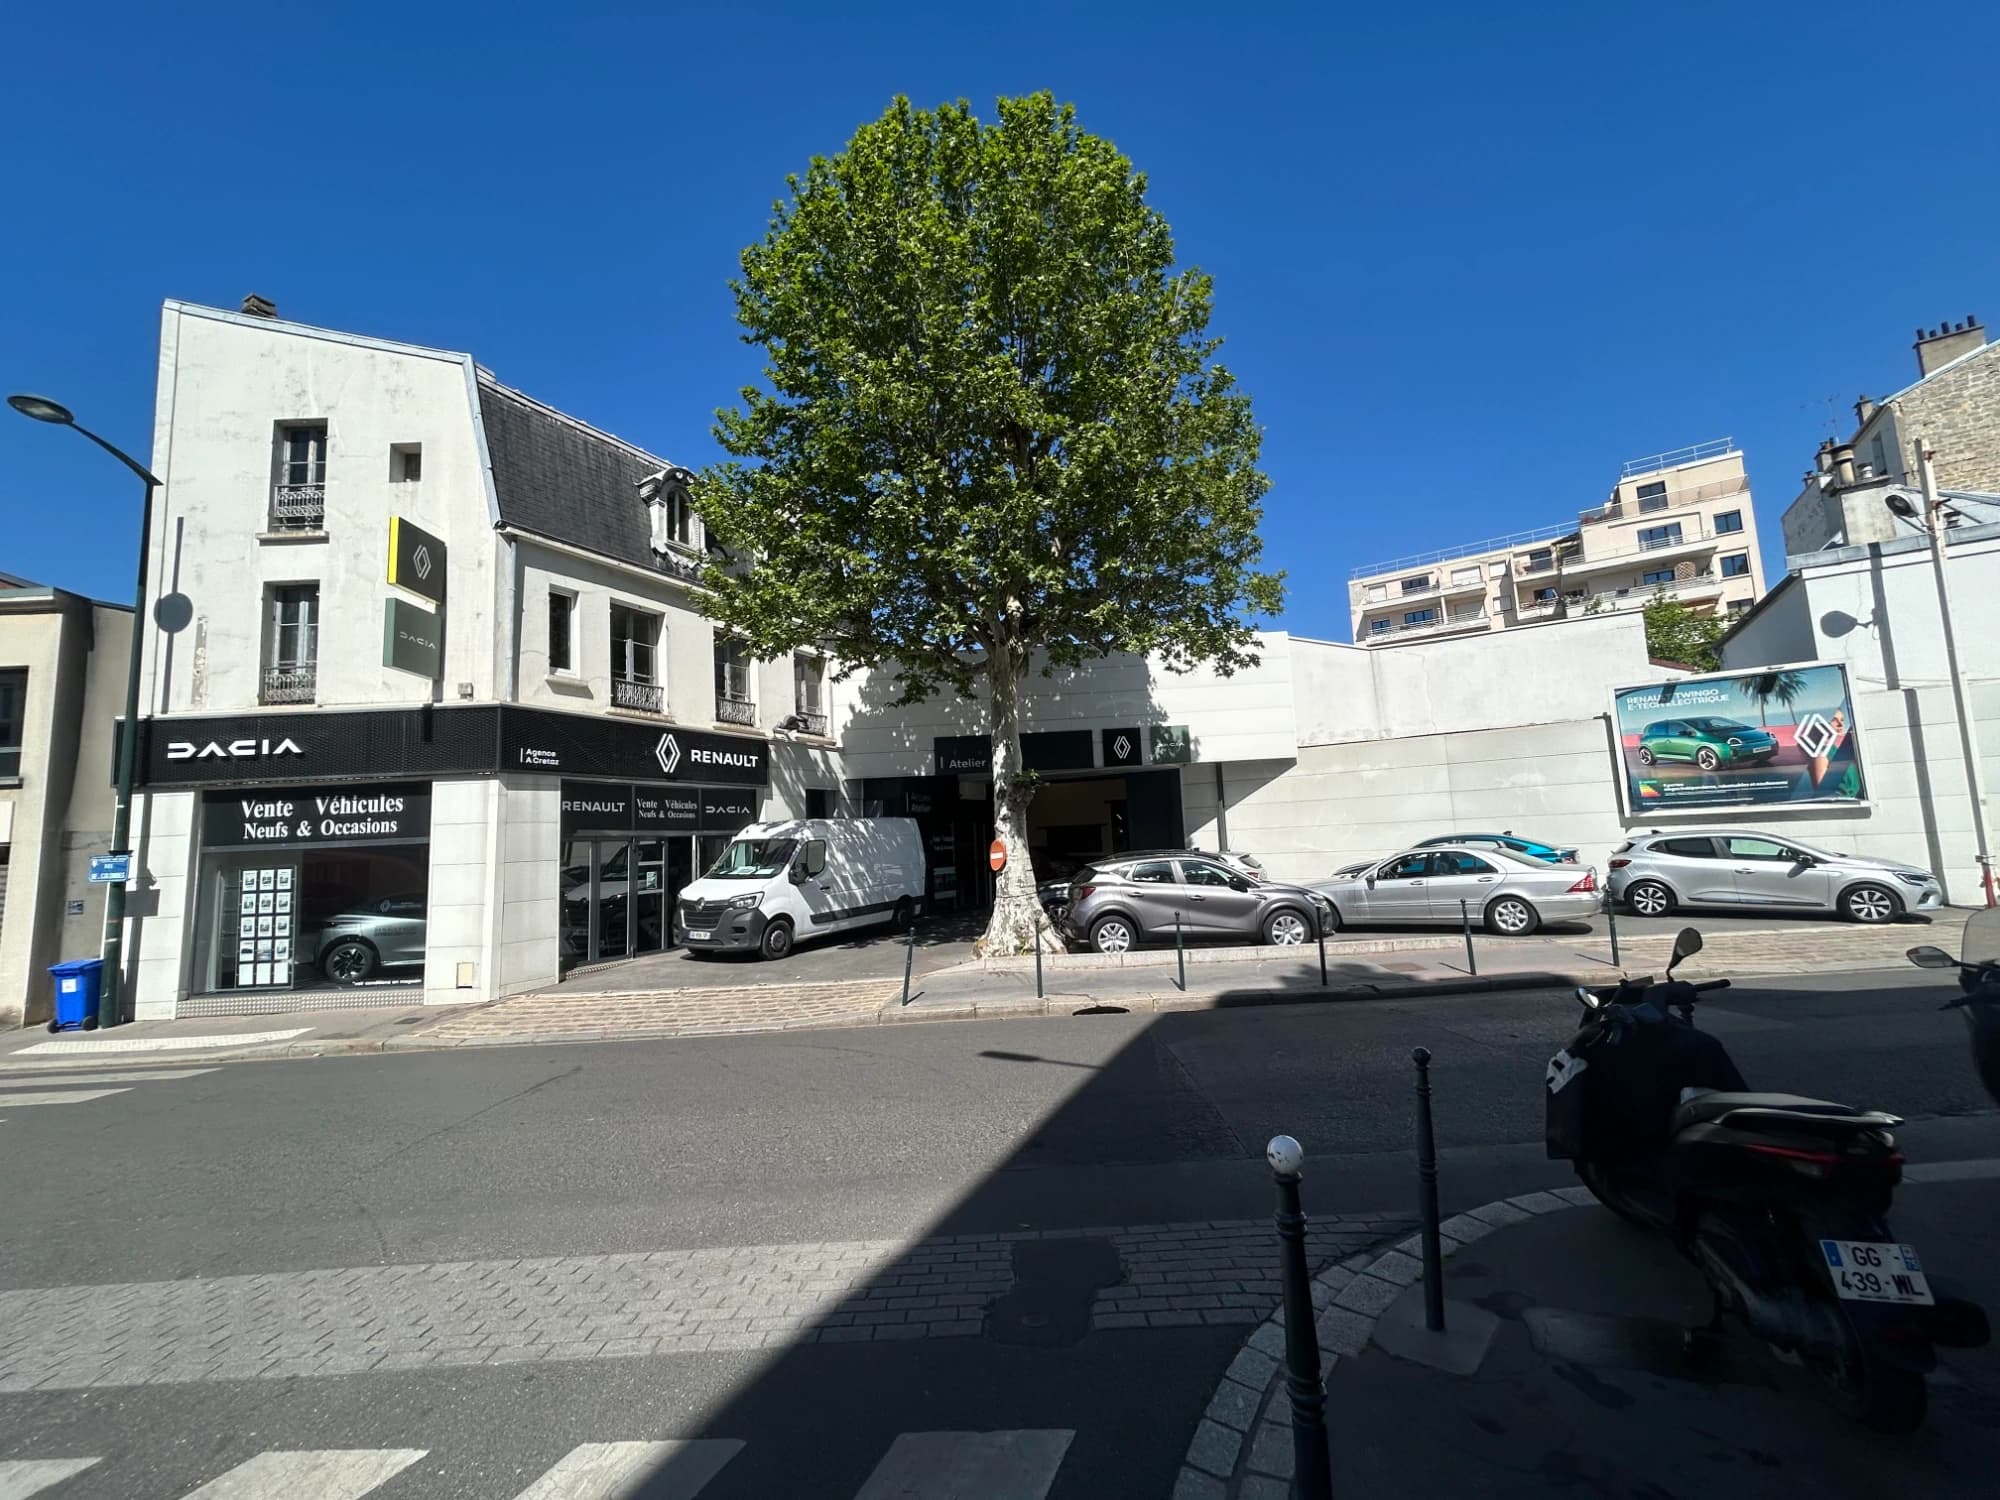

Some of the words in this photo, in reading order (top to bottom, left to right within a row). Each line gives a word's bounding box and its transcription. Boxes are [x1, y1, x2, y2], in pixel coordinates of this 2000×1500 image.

[399, 631, 436, 649] DACIA
[1675, 689, 1719, 699] TWINGO
[167, 738, 303, 758] DACIA
[525, 748, 556, 757] Agence
[691, 749, 759, 768] RENAULT
[949, 758, 986, 769] Atelier
[241, 800, 294, 818] Vente
[315, 794, 404, 816] Véhicules
[562, 801, 626, 813] RENAULT
[637, 798, 658, 809] Vente
[665, 799, 698, 810] Véhicules
[705, 805, 751, 814] DACIA
[638, 810, 657, 819] Neufs
[667, 810, 696, 819] Occasions
[243, 822, 289, 839] Neufs
[296, 820, 312, 837] &
[320, 818, 398, 836] Occasions
[1852, 1246, 1882, 1267] GG
